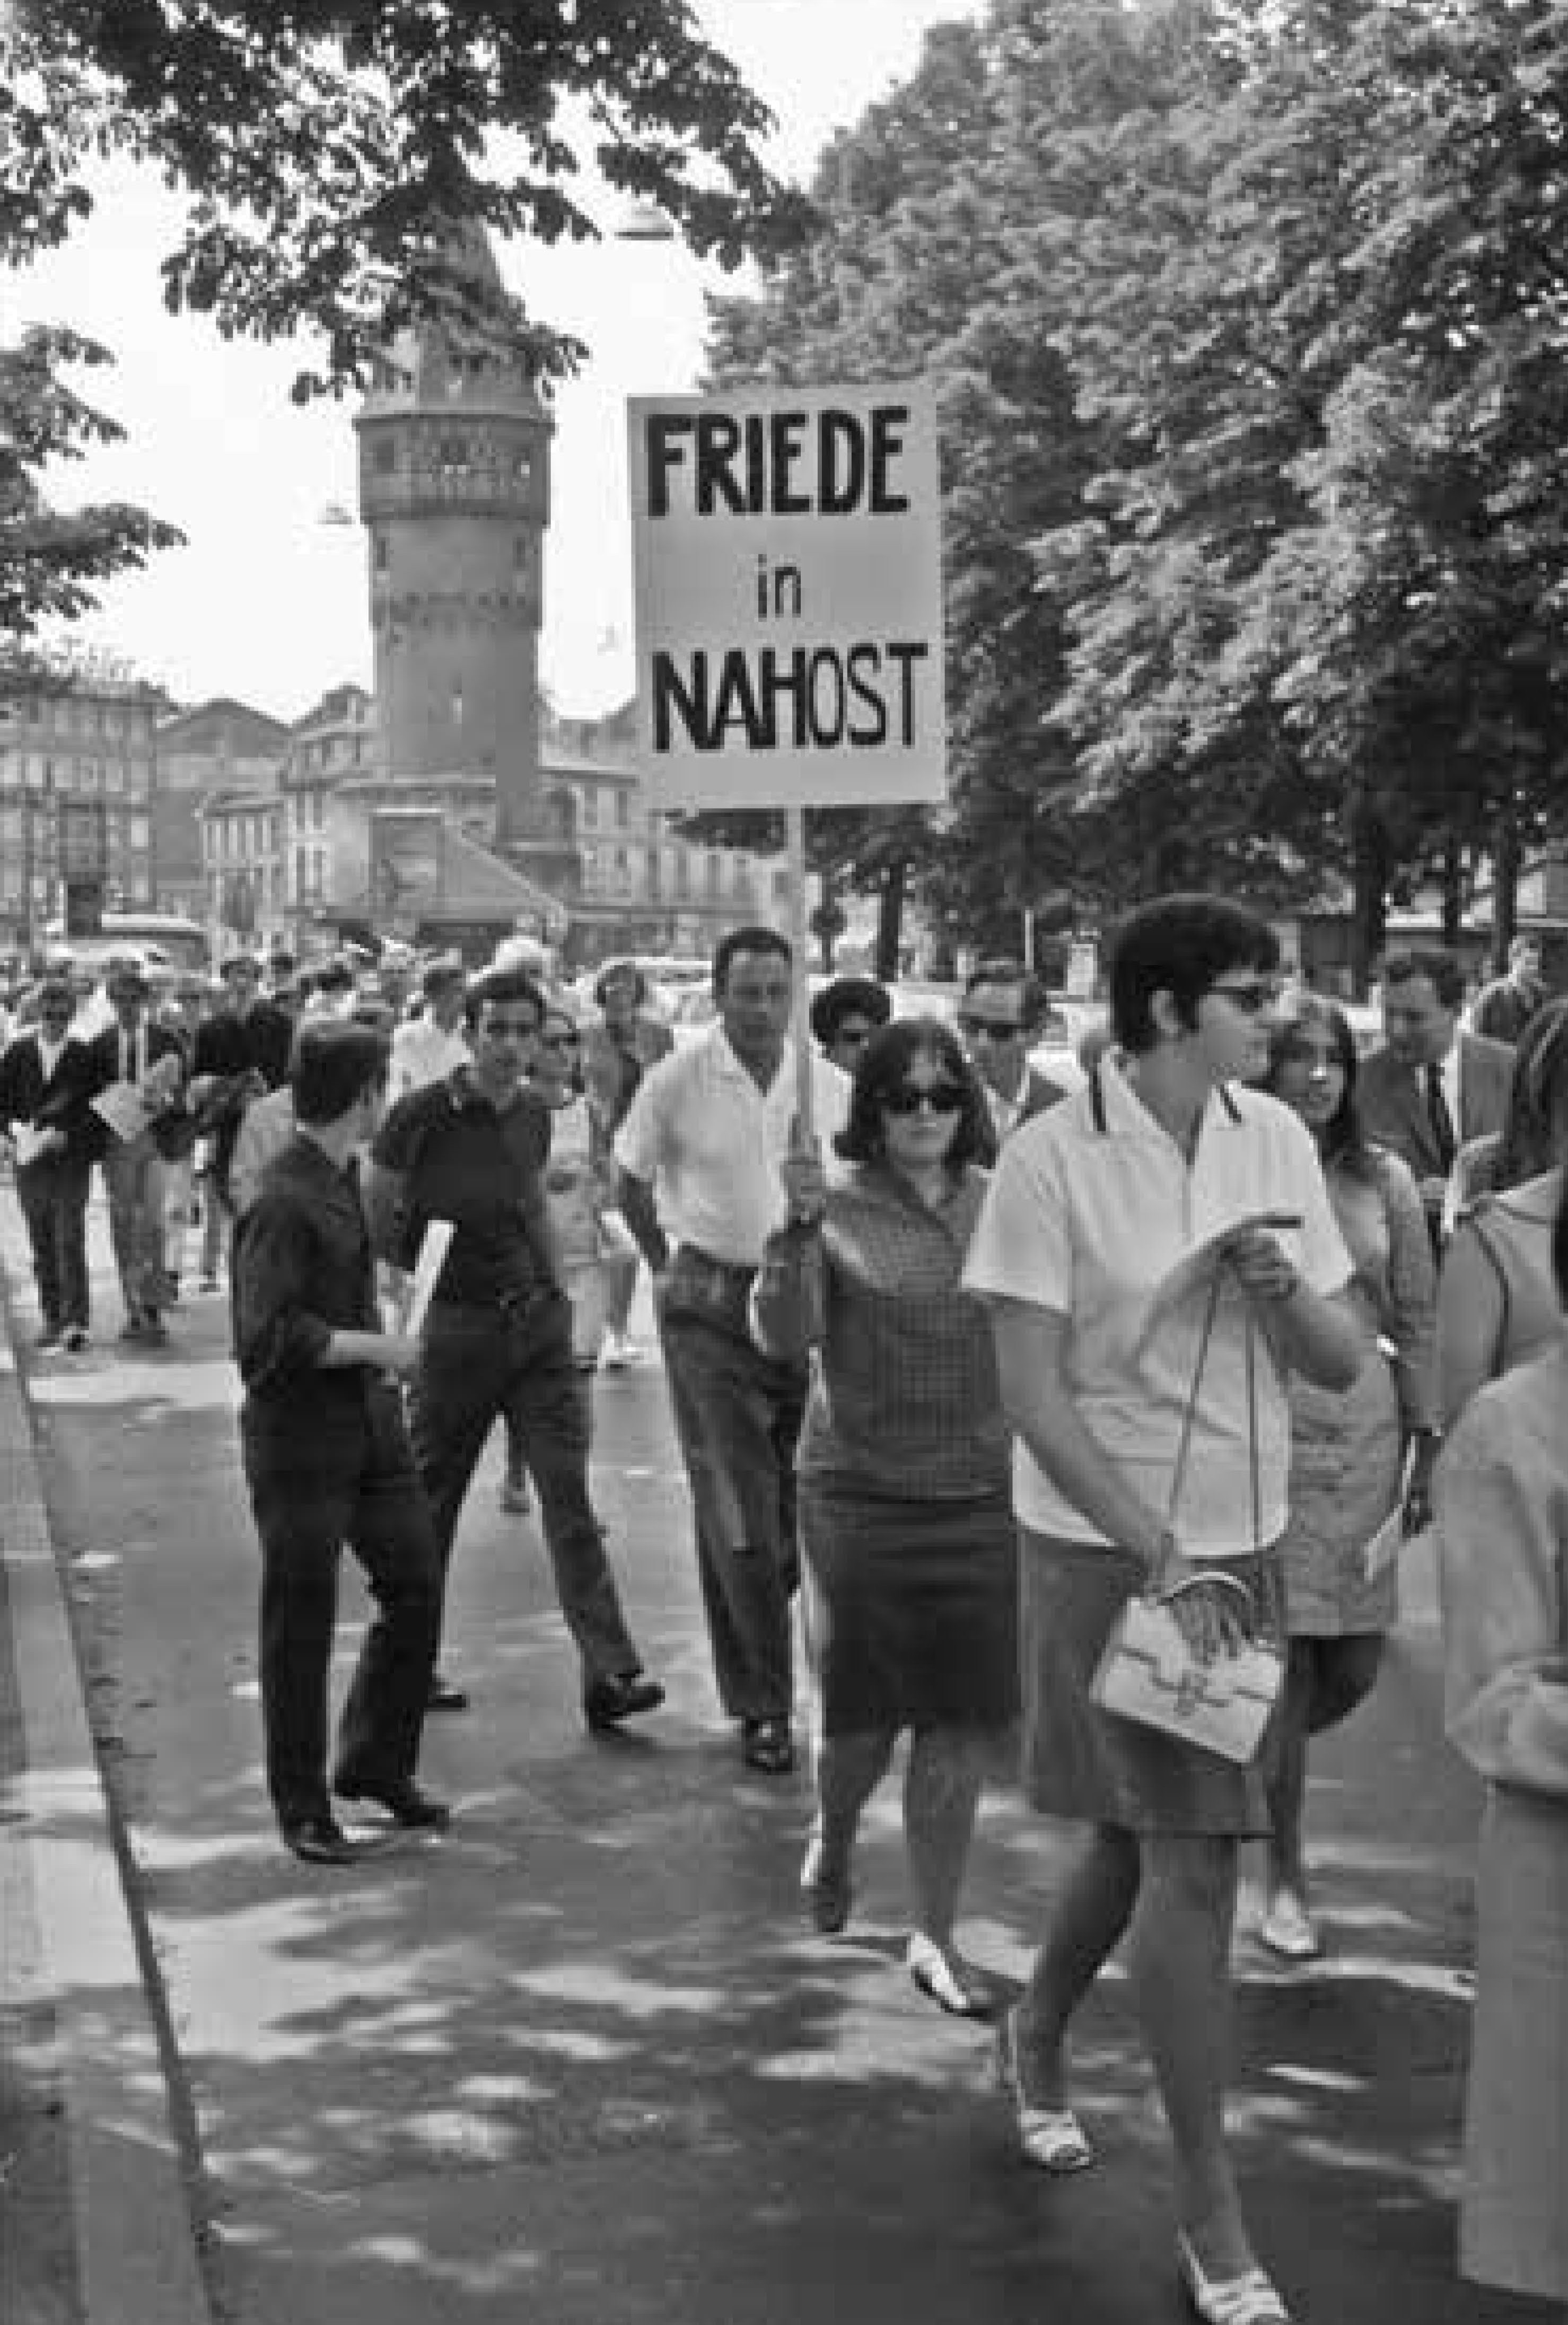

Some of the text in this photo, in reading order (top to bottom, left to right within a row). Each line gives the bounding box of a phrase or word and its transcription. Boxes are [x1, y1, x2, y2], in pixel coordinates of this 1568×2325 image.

[647, 406, 910, 515] FRIEDE
[758, 554, 801, 621] in
[652, 643, 929, 753] NAHOST
